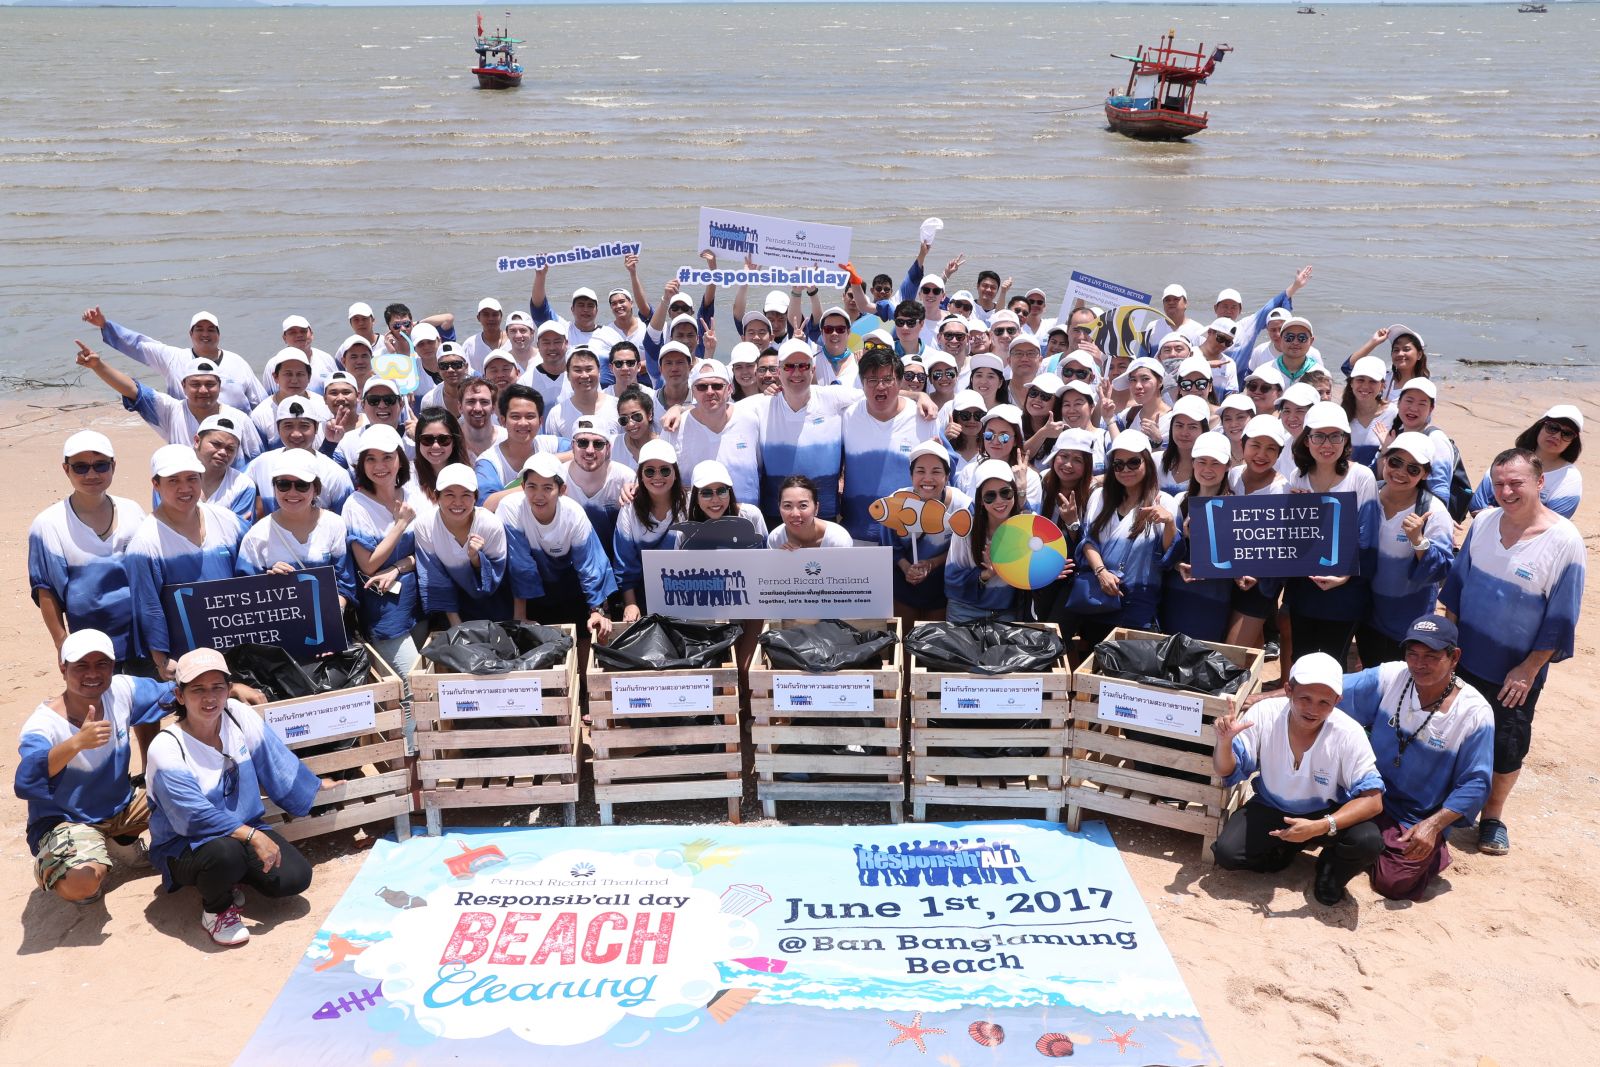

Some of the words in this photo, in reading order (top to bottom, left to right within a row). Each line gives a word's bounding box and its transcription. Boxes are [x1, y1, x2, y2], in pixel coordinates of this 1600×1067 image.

[808, 242, 835, 251] Thailand
[498, 243, 640, 271] #responsiballday
[679, 268, 847, 287] #responsiballday
[1232, 508, 1275, 522] LET'S
[1280, 507, 1319, 521] LIVE
[1233, 526, 1325, 541] TOGETHER,
[1234, 546, 1299, 560] BETTER
[758, 577, 792, 585] Pernod
[793, 577, 824, 585] Ricard
[826, 576, 870, 584] Thailand
[204, 592, 251, 610] LET'S
[254, 586, 298, 604] LIVE
[208, 606, 306, 629] TOGETHER,
[213, 629, 281, 649] BETTER
[547, 879, 596, 887] Ricard
[600, 877, 669, 886] Thailand
[454, 891, 631, 908] Responsib'all
[638, 893, 691, 909] day
[783, 897, 902, 924] June
[919, 895, 996, 920] 1st,
[1005, 886, 1113, 914] 2017
[438, 911, 676, 966] BEACH
[896, 931, 1138, 953] Banglamung
[905, 952, 1024, 975] Beach
